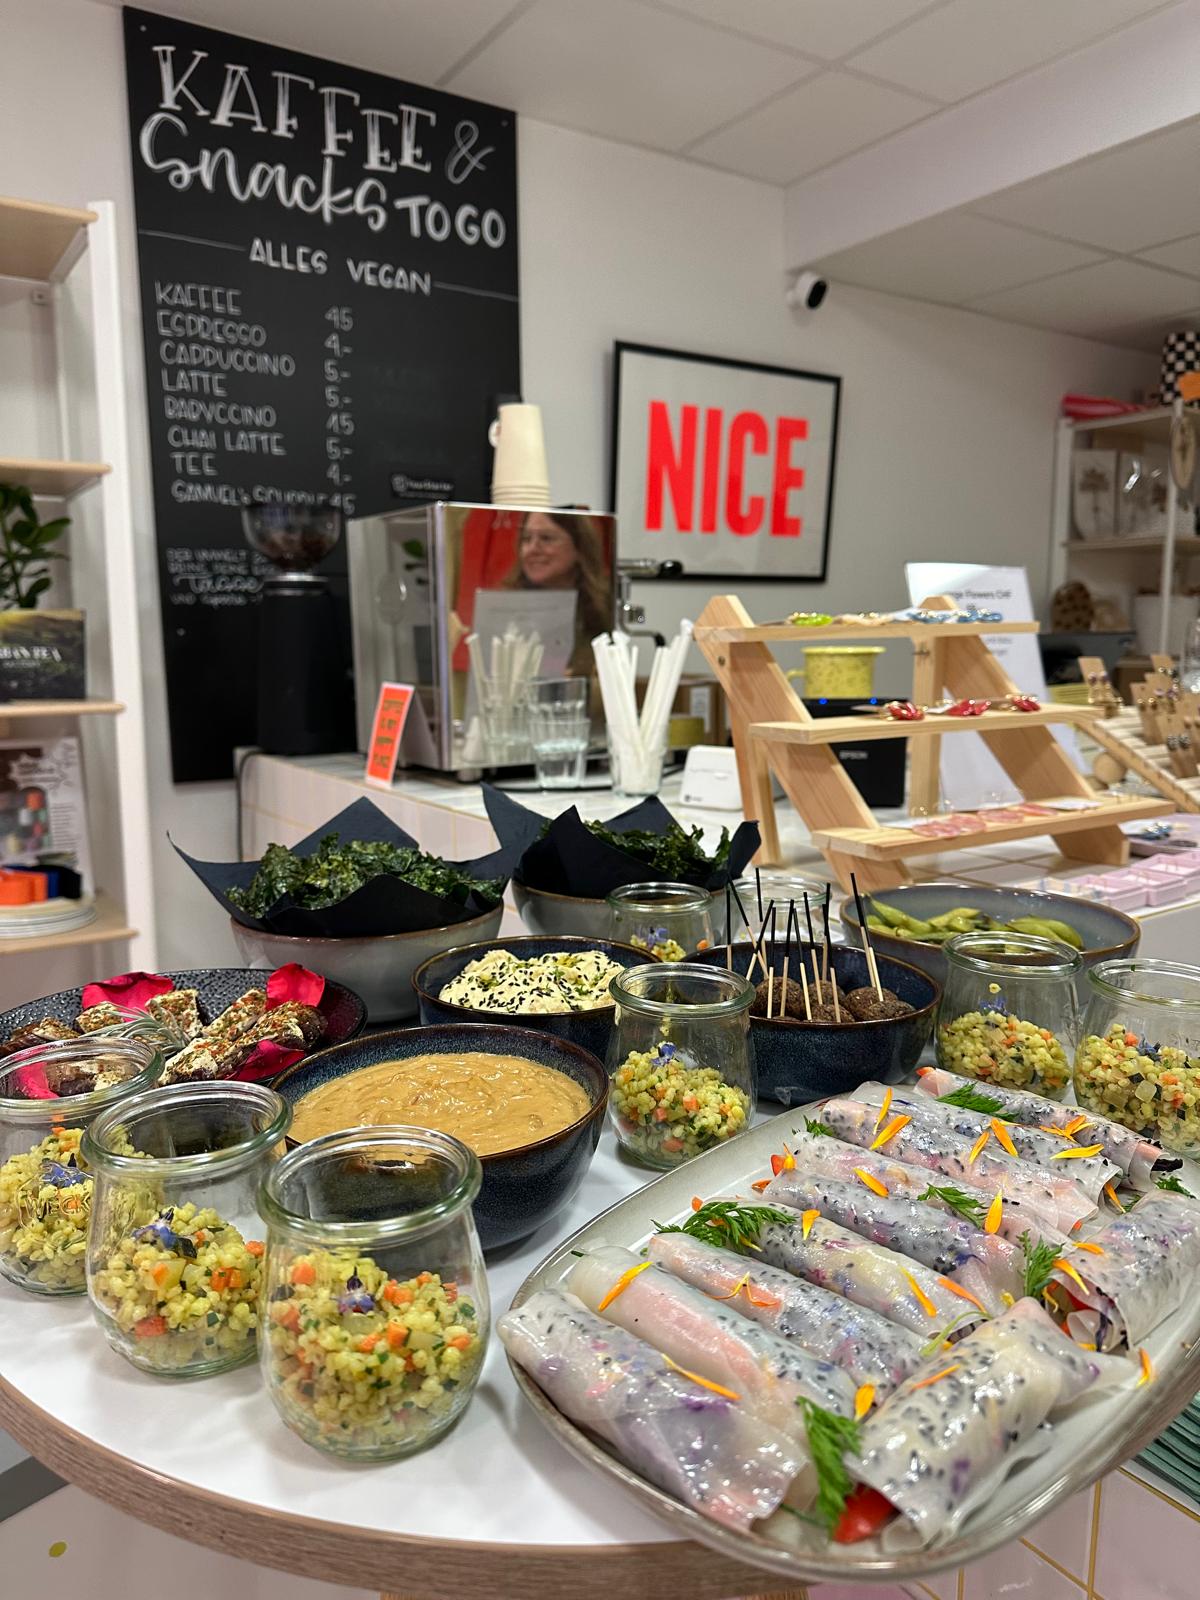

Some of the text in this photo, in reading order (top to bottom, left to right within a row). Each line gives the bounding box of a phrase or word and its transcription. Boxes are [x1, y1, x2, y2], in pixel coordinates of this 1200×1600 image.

[152, 45, 494, 184] KAFFEE &
[139, 113, 387, 232] Snacks
[249, 238, 431, 295] ALLES VEGAN
[154, 281, 242, 315] KAFFEE
[155, 310, 267, 346] ESPRESSO
[159, 340, 296, 376] CAPPUCCINO
[160, 368, 228, 396] LATTE
[166, 425, 217, 450] CHAI
[223, 431, 286, 456] LATTE
[170, 451, 218, 477] TEE
[645, 400, 808, 538] NICE
